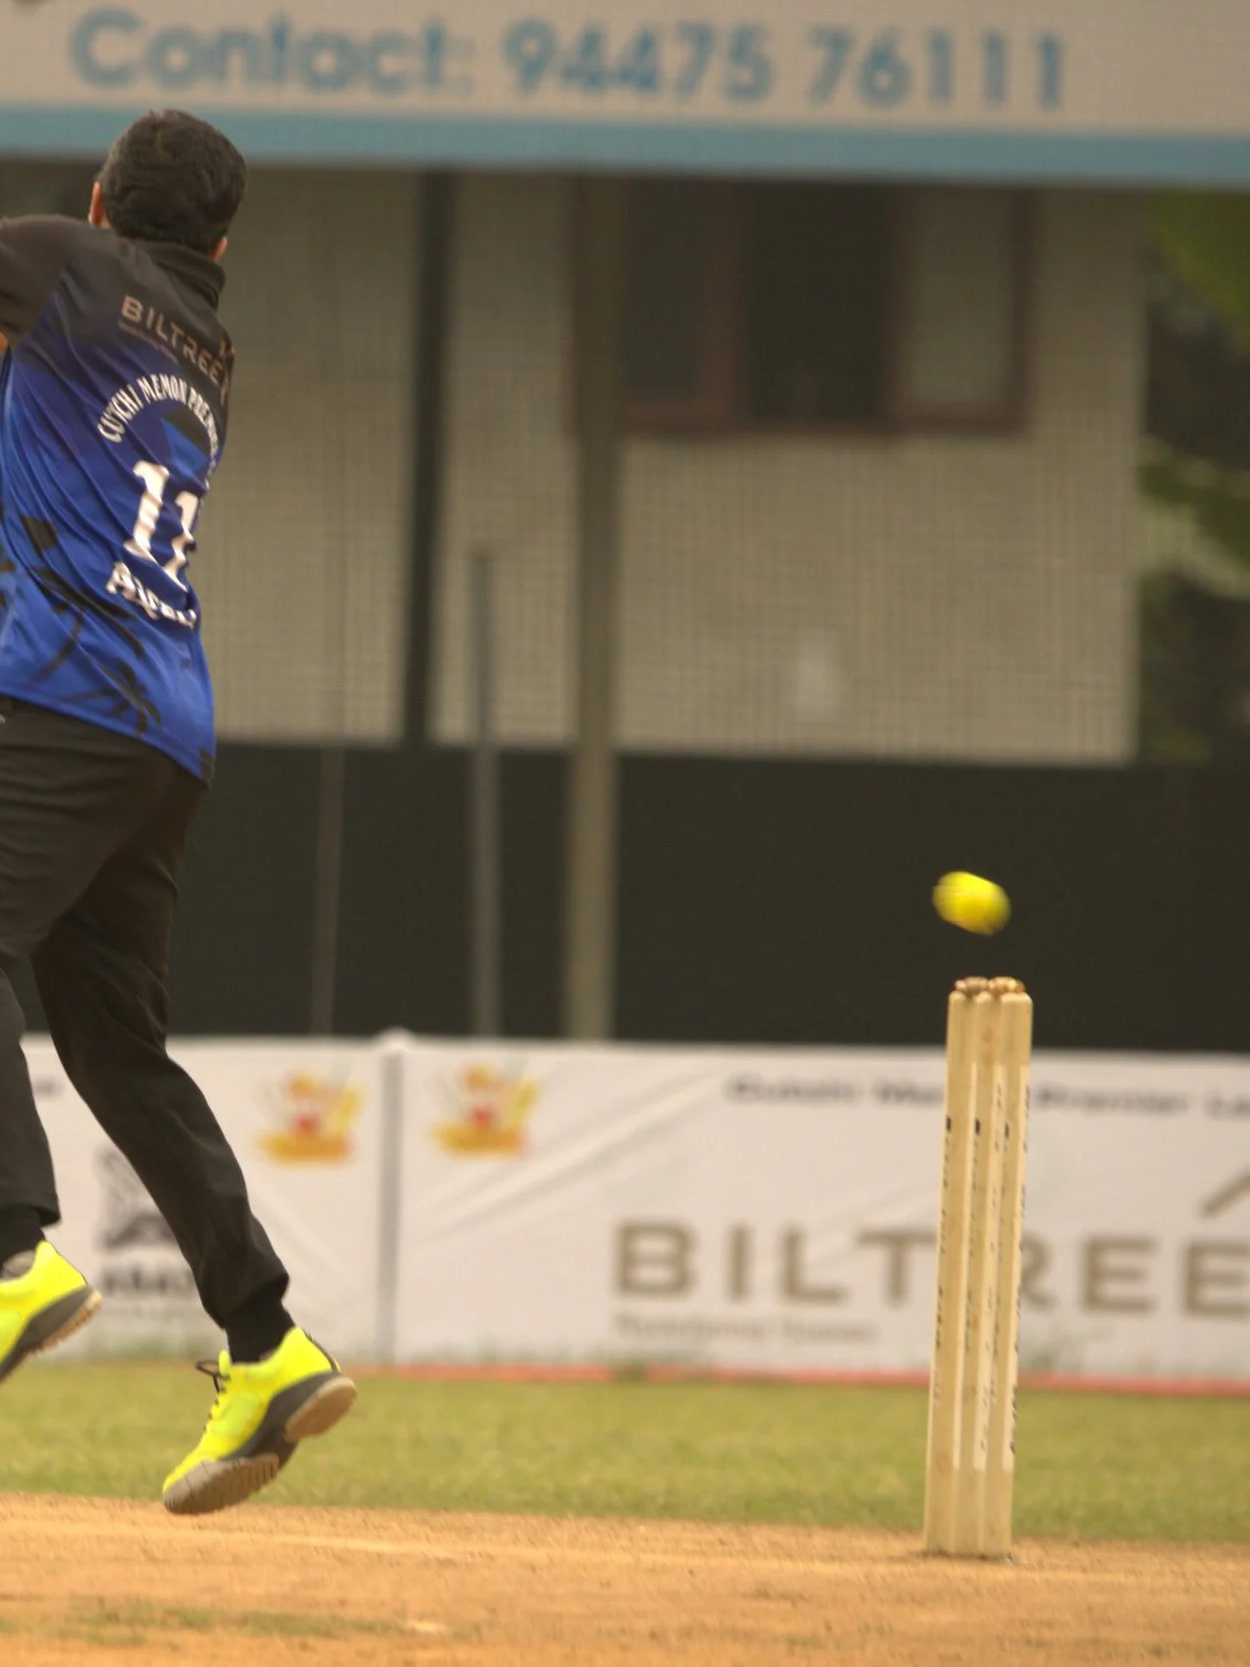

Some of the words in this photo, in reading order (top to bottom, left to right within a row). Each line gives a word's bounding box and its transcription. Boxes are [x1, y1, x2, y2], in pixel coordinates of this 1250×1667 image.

[69, 7, 474, 92] Contact:
[501, 17, 772, 106] 94475
[805, 27, 1066, 110] 76111
[97, 384, 144, 443] CUTCHI
[123, 459, 200, 593] 11
